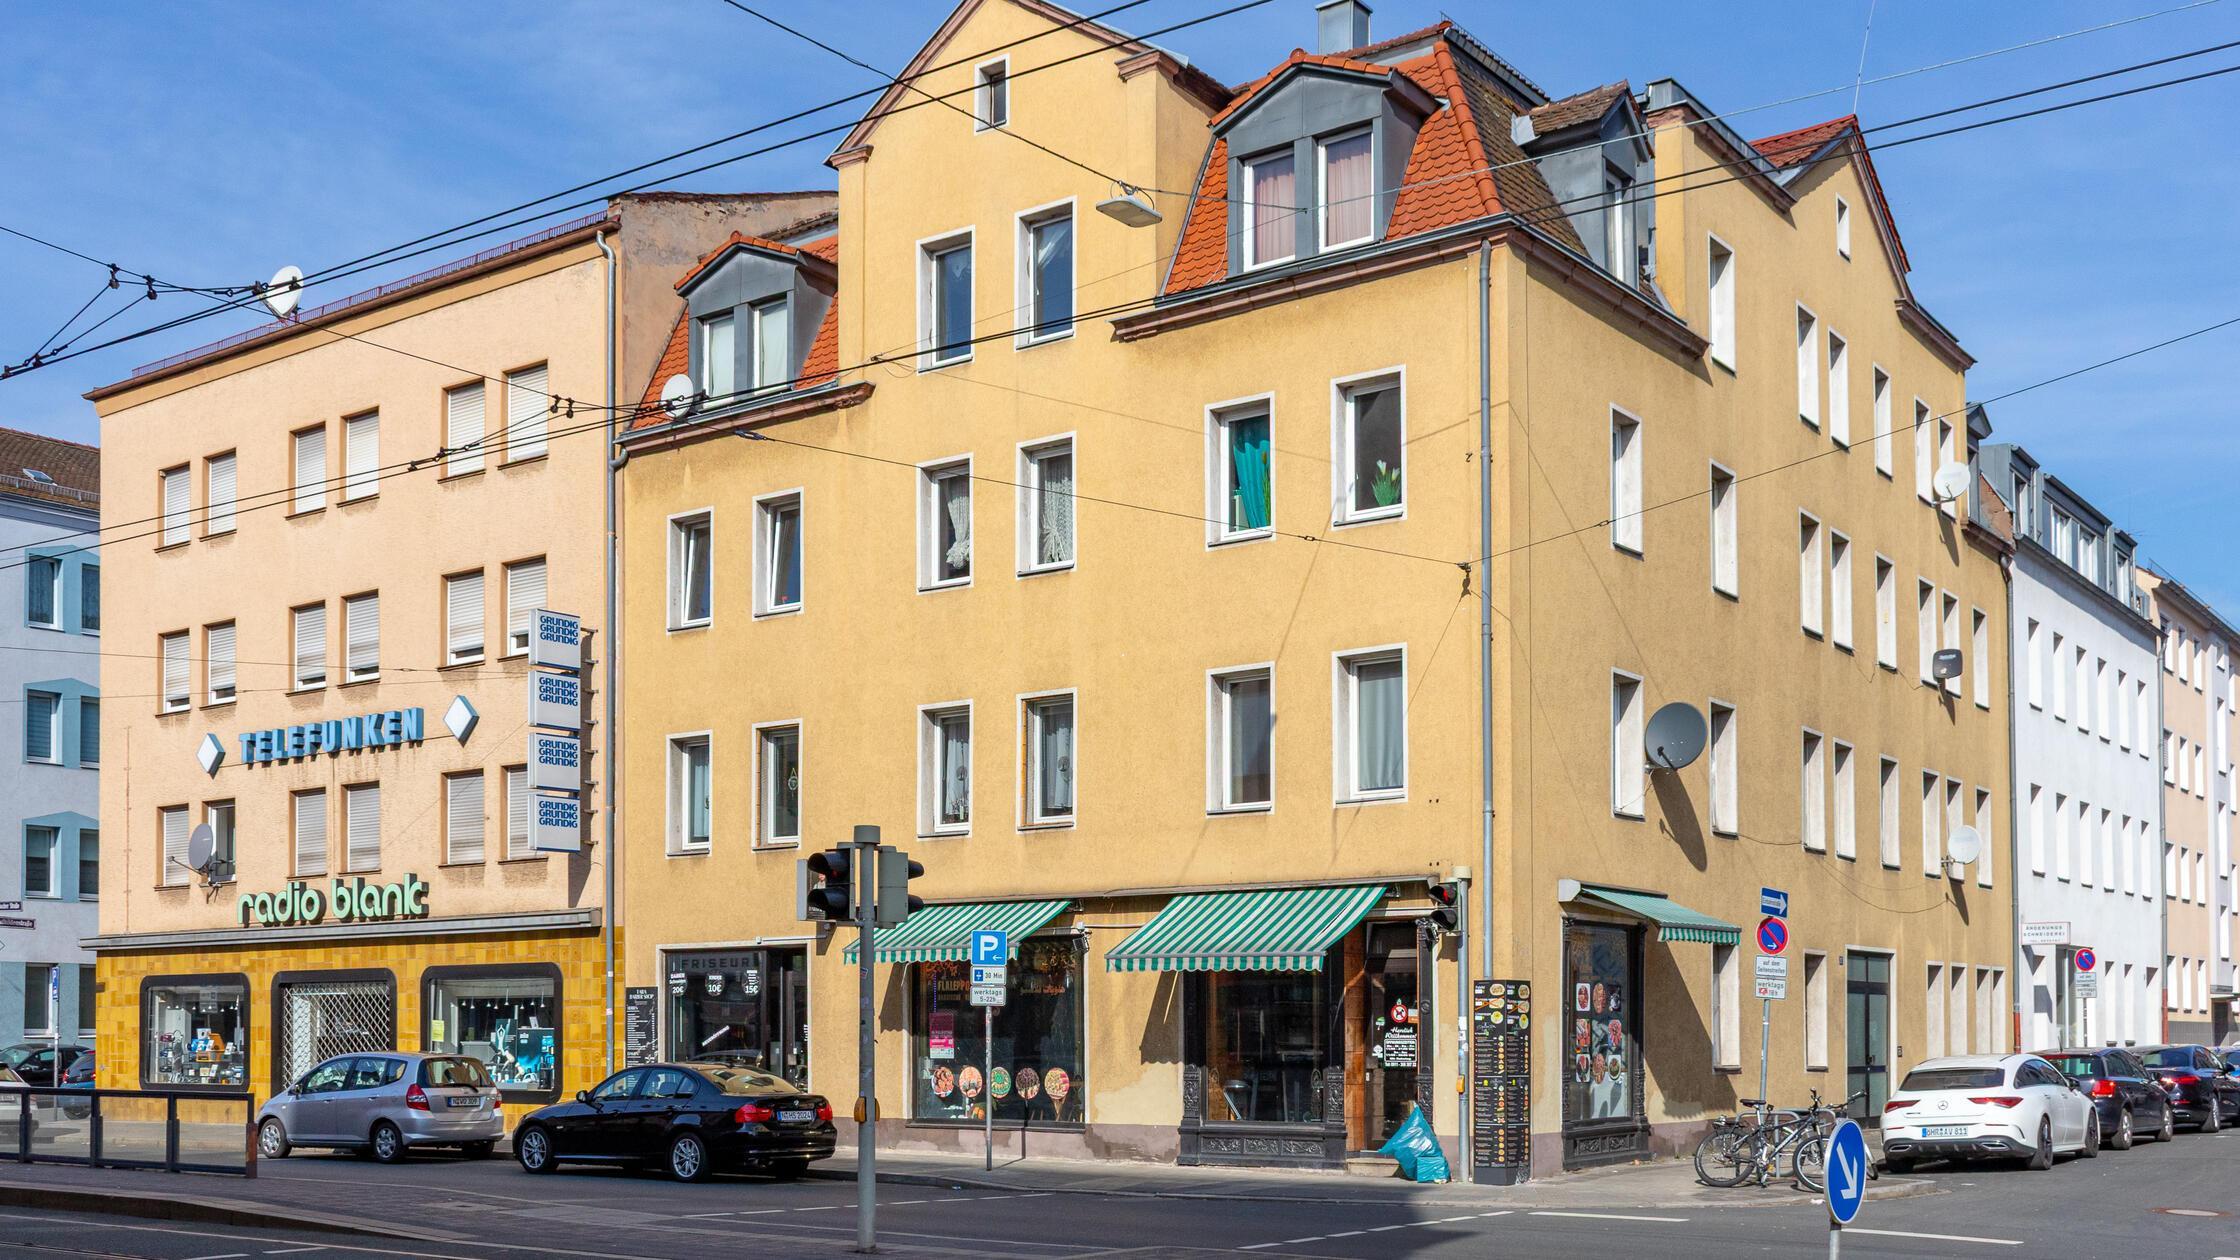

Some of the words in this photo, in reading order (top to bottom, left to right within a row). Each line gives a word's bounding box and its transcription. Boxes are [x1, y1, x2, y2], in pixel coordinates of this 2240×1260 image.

[540, 616, 578, 630] GRUNDIG
[540, 624, 578, 638] GRUNDIG
[540, 632, 578, 646] GRUNDIG
[539, 677, 578, 690] GRUNDIG
[539, 686, 578, 698] GRUNDIG
[539, 694, 578, 707] GRUNDIG
[239, 707, 424, 765] TELEFUNKEN
[539, 739, 578, 751] GRUNDIG
[539, 748, 578, 759] GRUNDIG
[539, 756, 578, 768] GRUNDIG
[539, 801, 578, 812] GRUNDIG
[539, 809, 578, 820] GRUNDIG
[539, 817, 578, 828] GRUNDIG
[237, 881, 325, 925] radio
[331, 873, 429, 920] blank
[980, 935, 998, 961] P
[682, 957, 750, 969] FRISEUR
[708, 984, 722, 992] 10€
[745, 985, 759, 994] 15€
